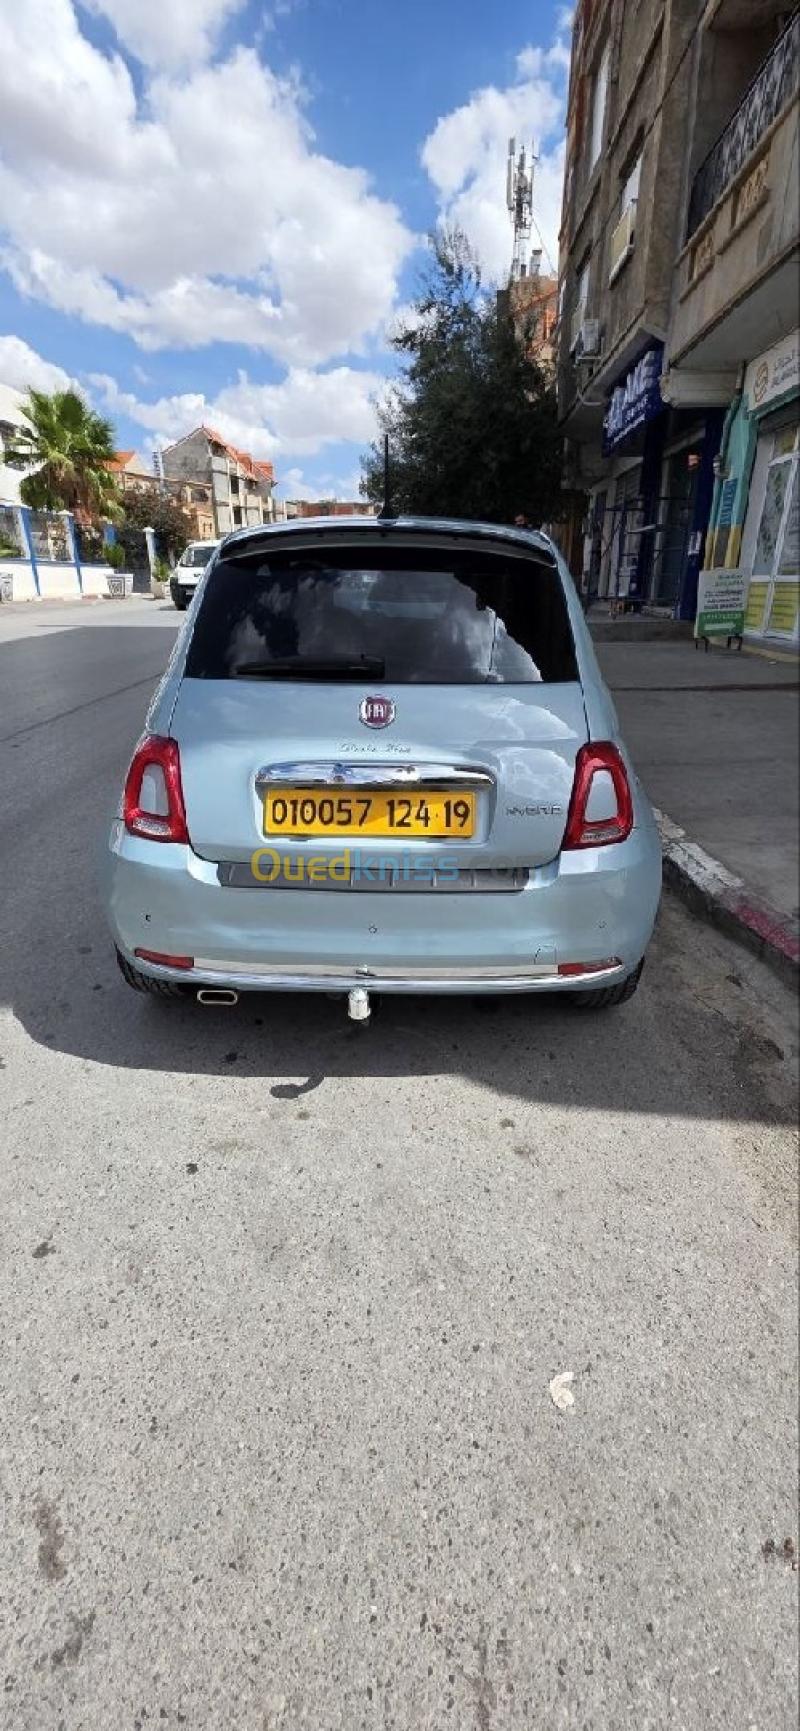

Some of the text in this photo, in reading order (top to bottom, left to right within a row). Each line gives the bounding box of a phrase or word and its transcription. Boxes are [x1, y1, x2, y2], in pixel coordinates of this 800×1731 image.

[272, 798, 471, 828] 010057 124 19
